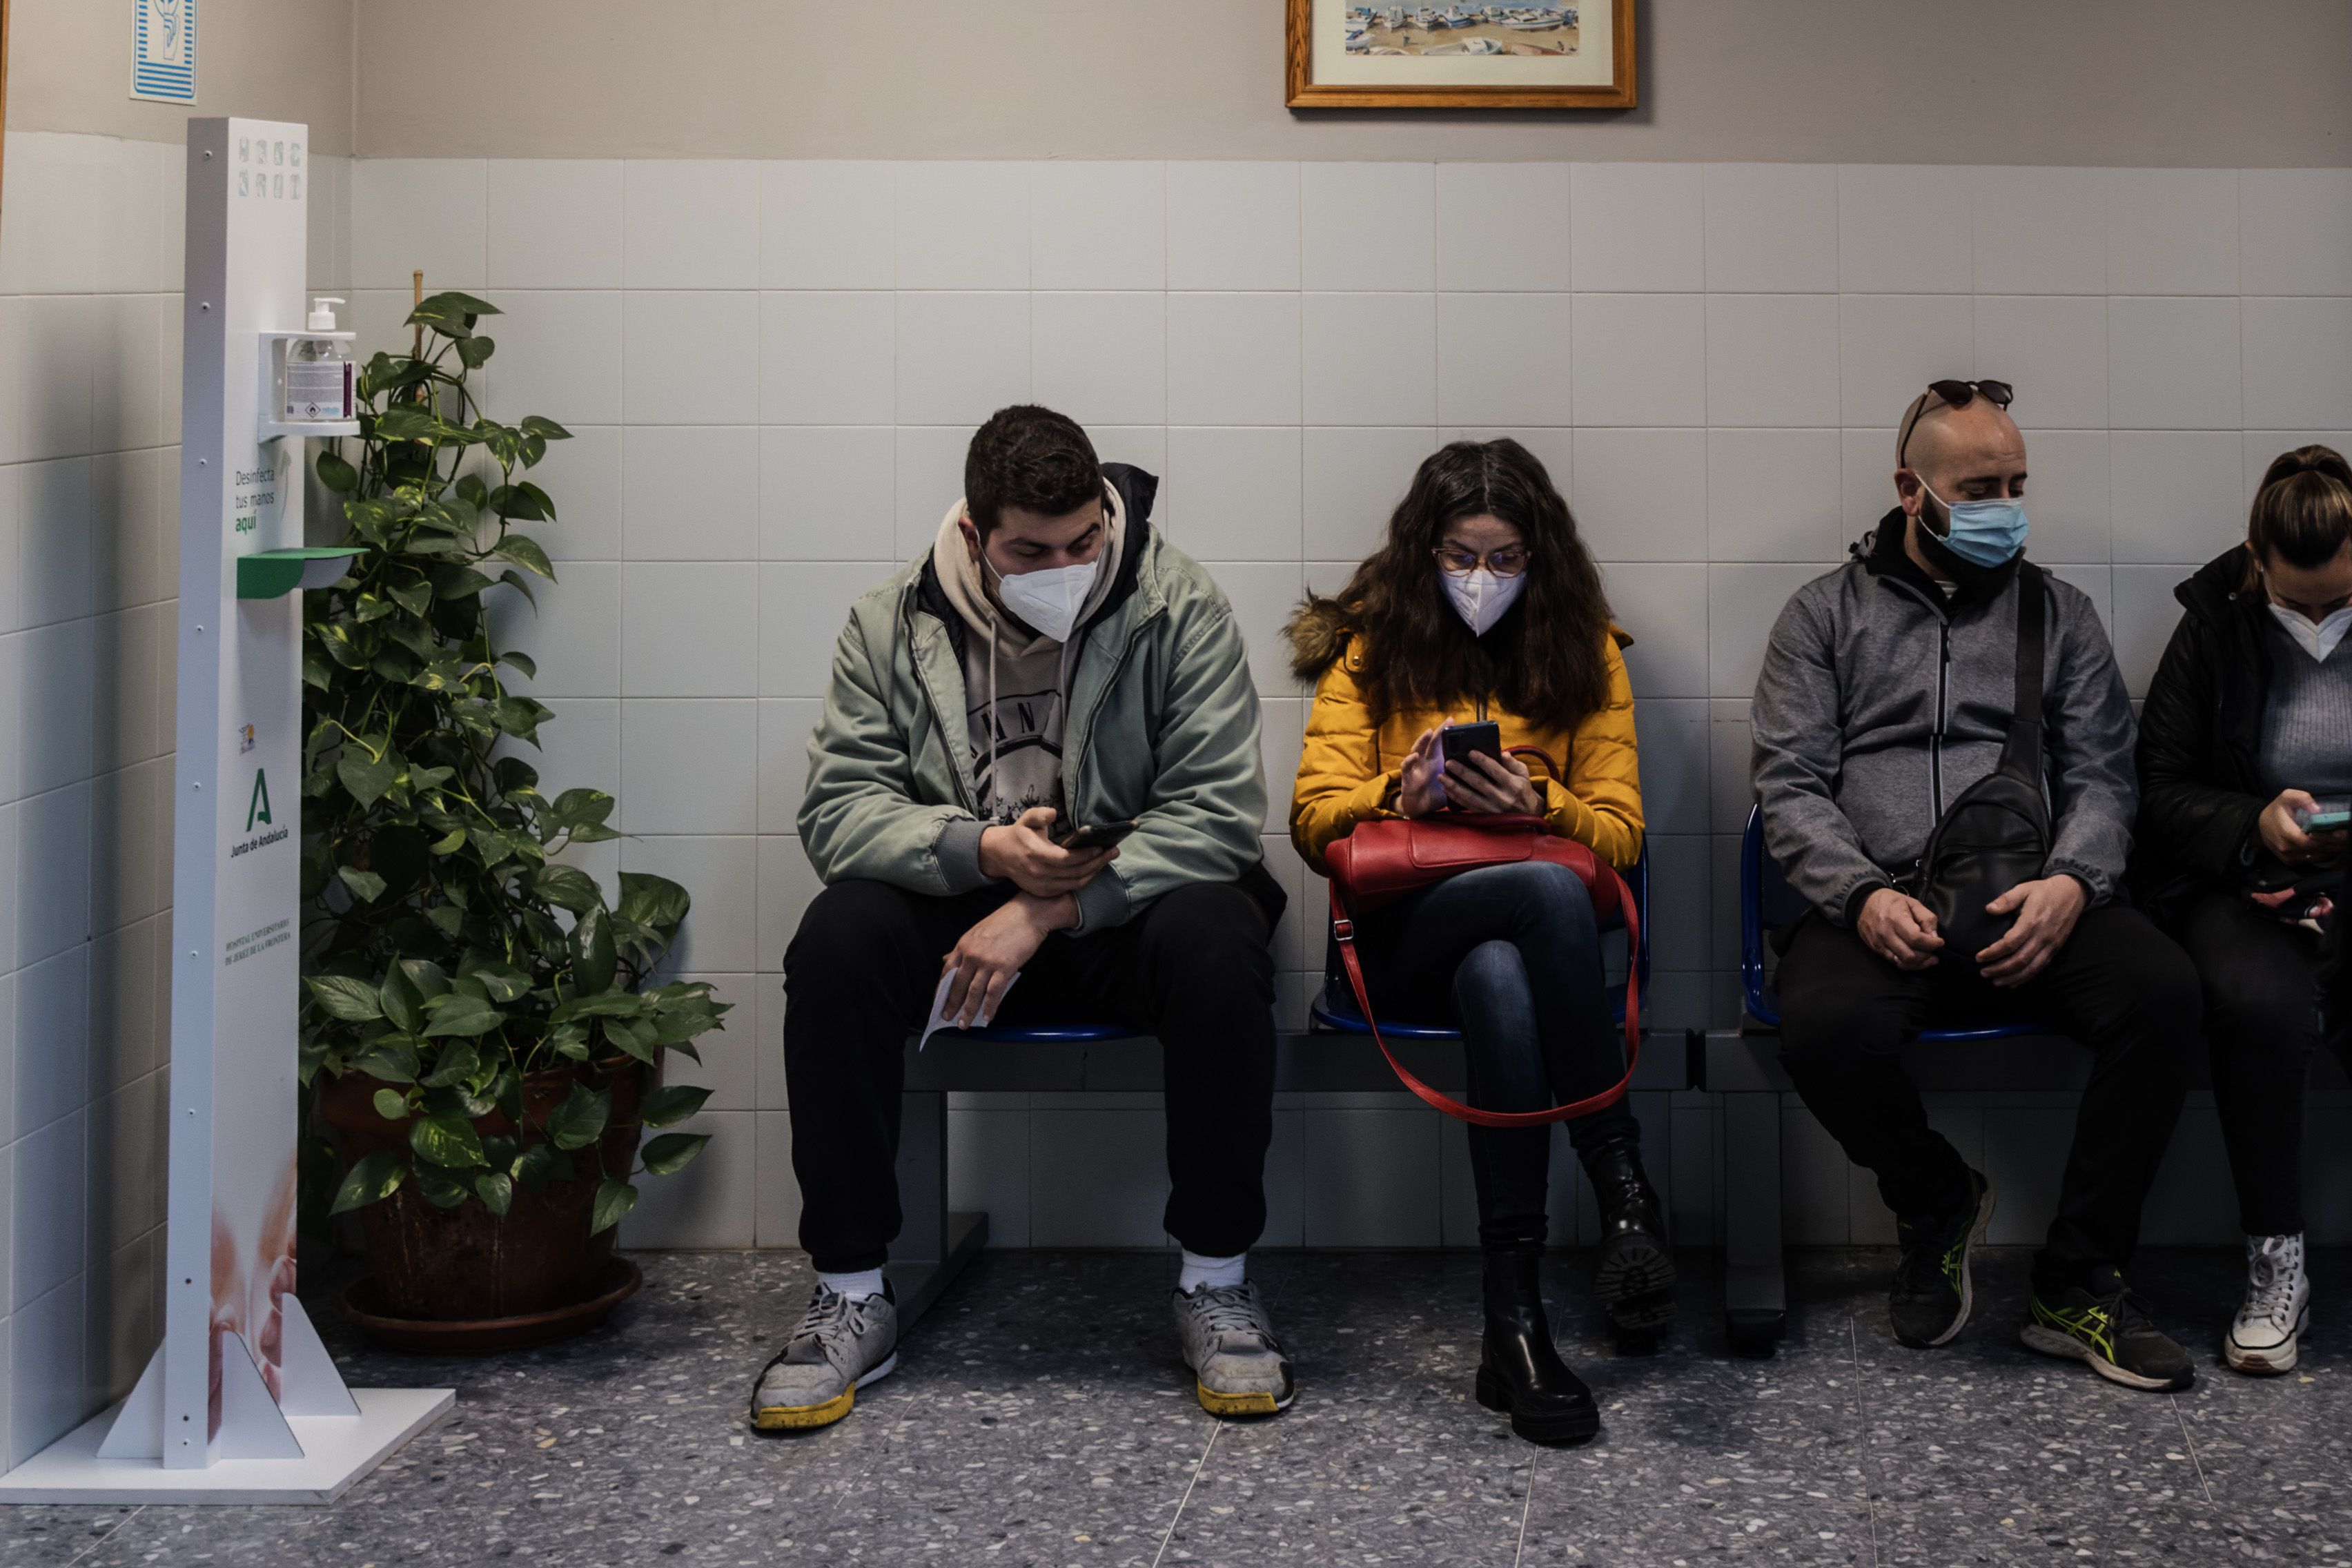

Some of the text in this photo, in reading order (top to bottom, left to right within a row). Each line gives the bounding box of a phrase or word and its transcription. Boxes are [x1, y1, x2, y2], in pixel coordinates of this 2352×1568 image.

[236, 467, 275, 486] Desinfecta
[236, 491, 275, 509] tus manos
[235, 509, 257, 536] aquí
[231, 825, 288, 858] Junta de Andalucía
